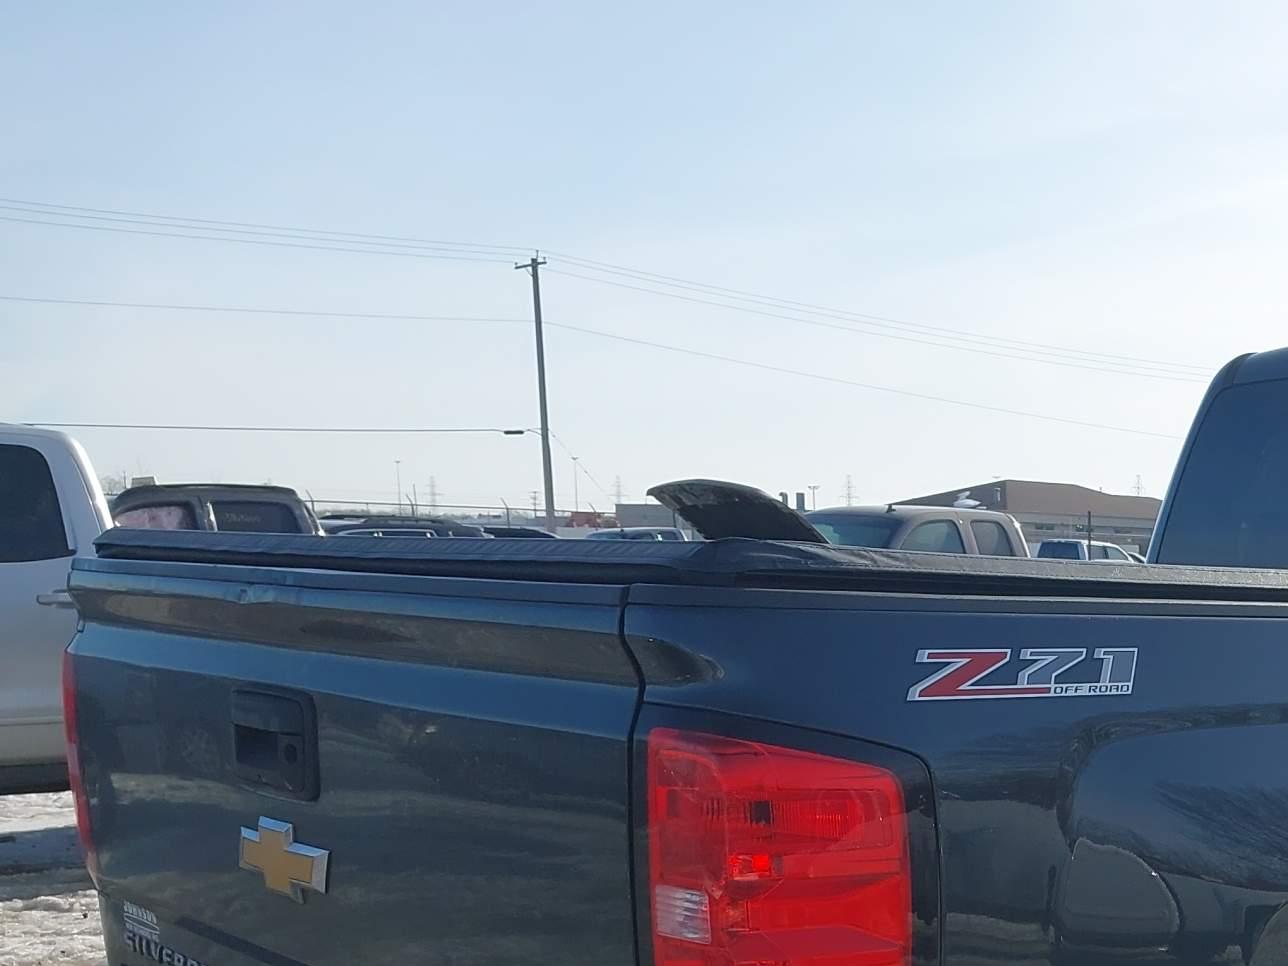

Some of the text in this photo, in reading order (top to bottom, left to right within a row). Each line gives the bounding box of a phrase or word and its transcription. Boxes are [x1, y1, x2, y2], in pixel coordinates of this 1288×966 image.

[907, 647, 1138, 700] Z71
[1053, 684, 1130, 695] OFF ROAD
